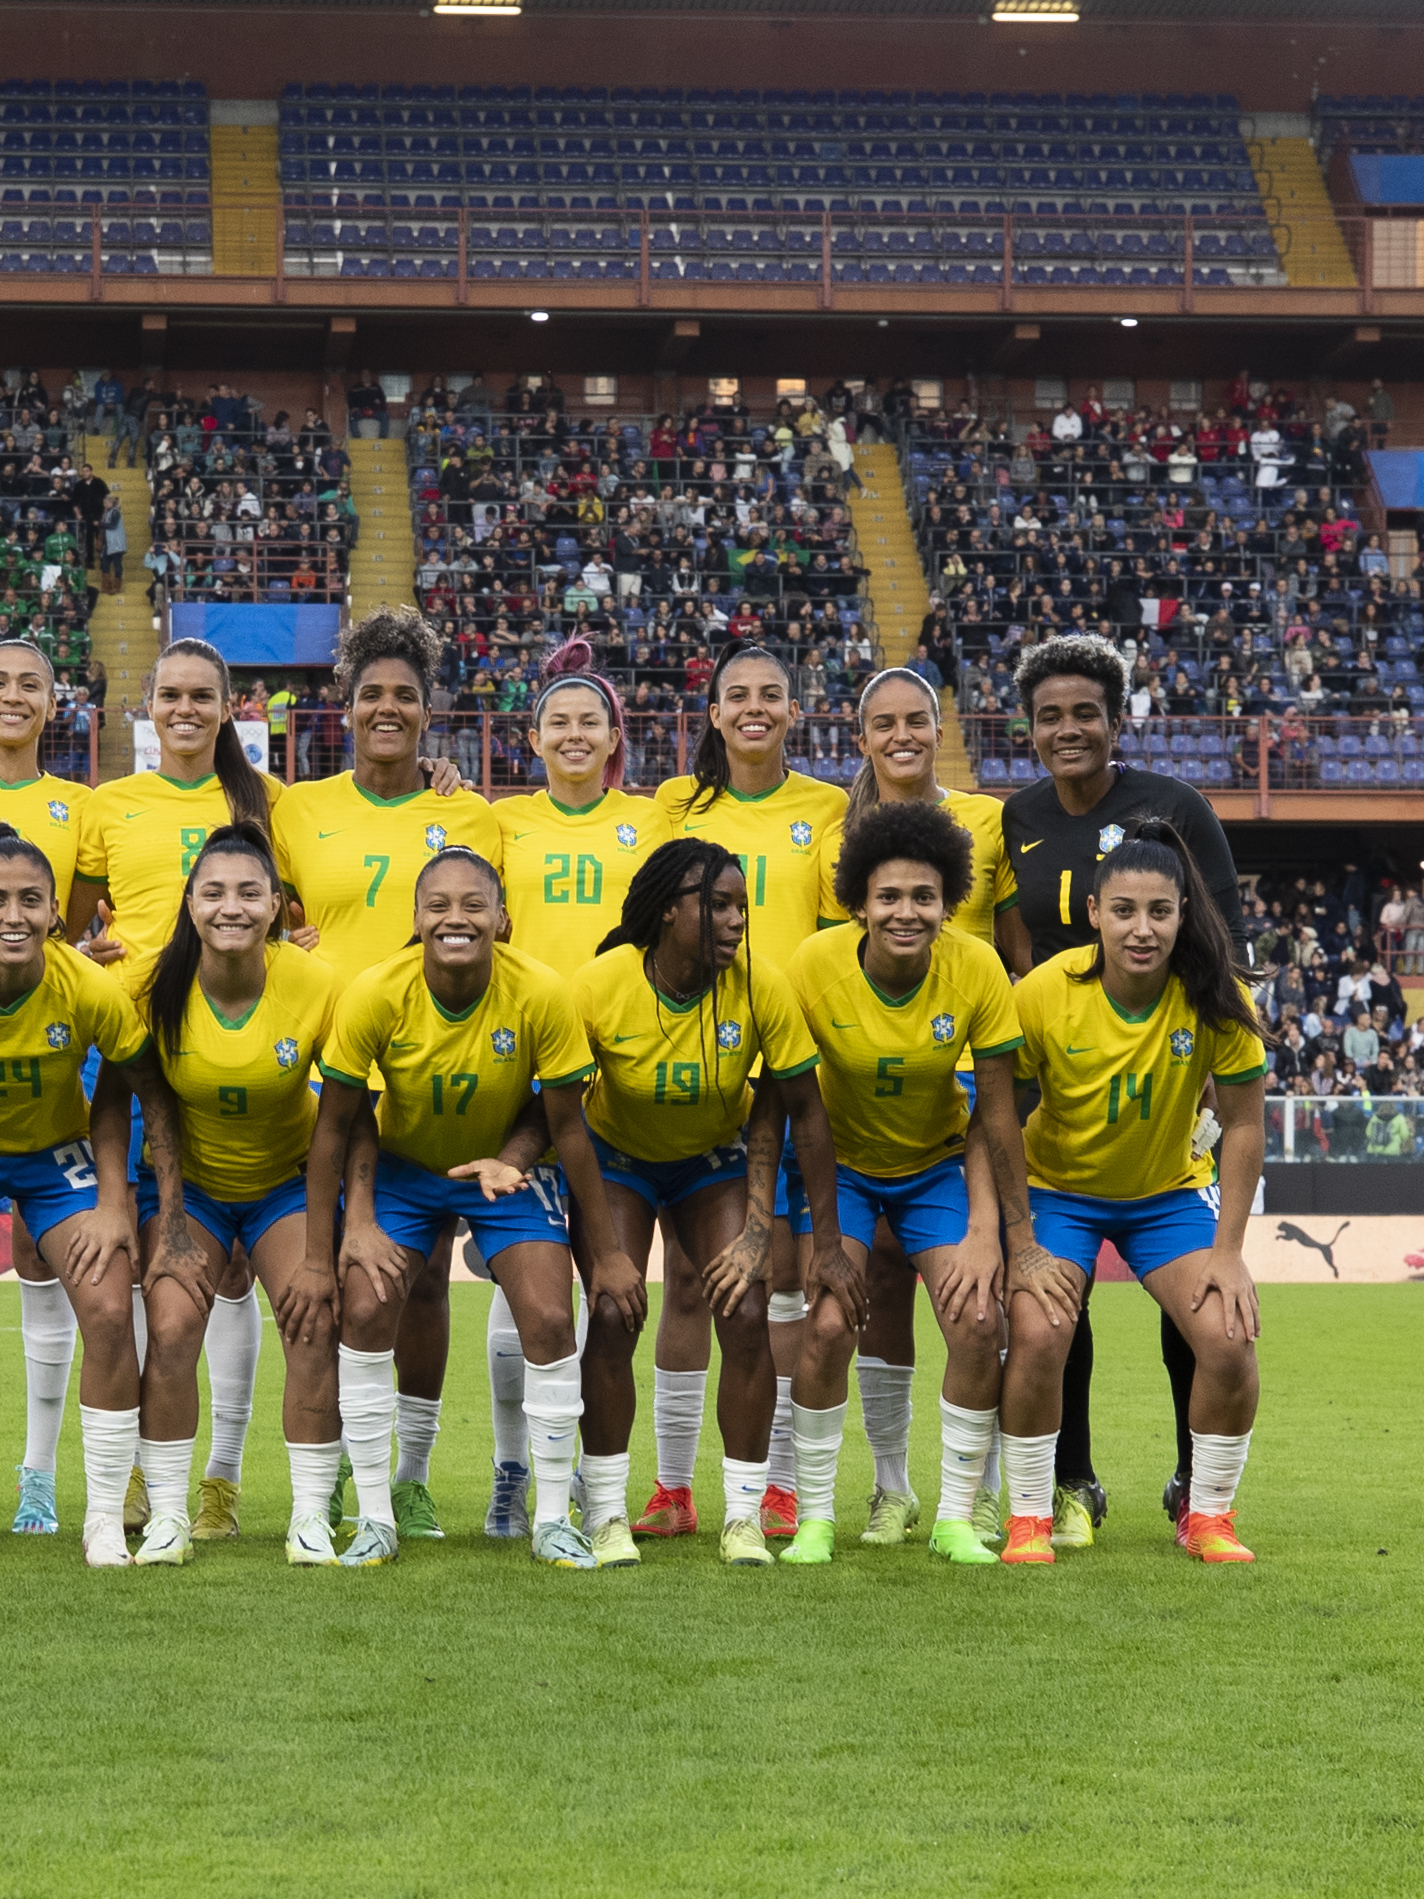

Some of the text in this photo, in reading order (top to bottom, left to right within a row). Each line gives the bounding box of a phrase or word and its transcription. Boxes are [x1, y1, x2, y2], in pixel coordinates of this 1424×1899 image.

[181, 828, 207, 877] 8
[363, 855, 391, 908] 7
[544, 853, 603, 905] 20
[740, 854, 766, 906] 1
[1060, 869, 1073, 925] 1
[219, 1086, 248, 1116] 9
[431, 1073, 479, 1116] 17
[654, 1061, 701, 1106] 19
[875, 1057, 906, 1098] 5
[1107, 1072, 1153, 1125] 14
